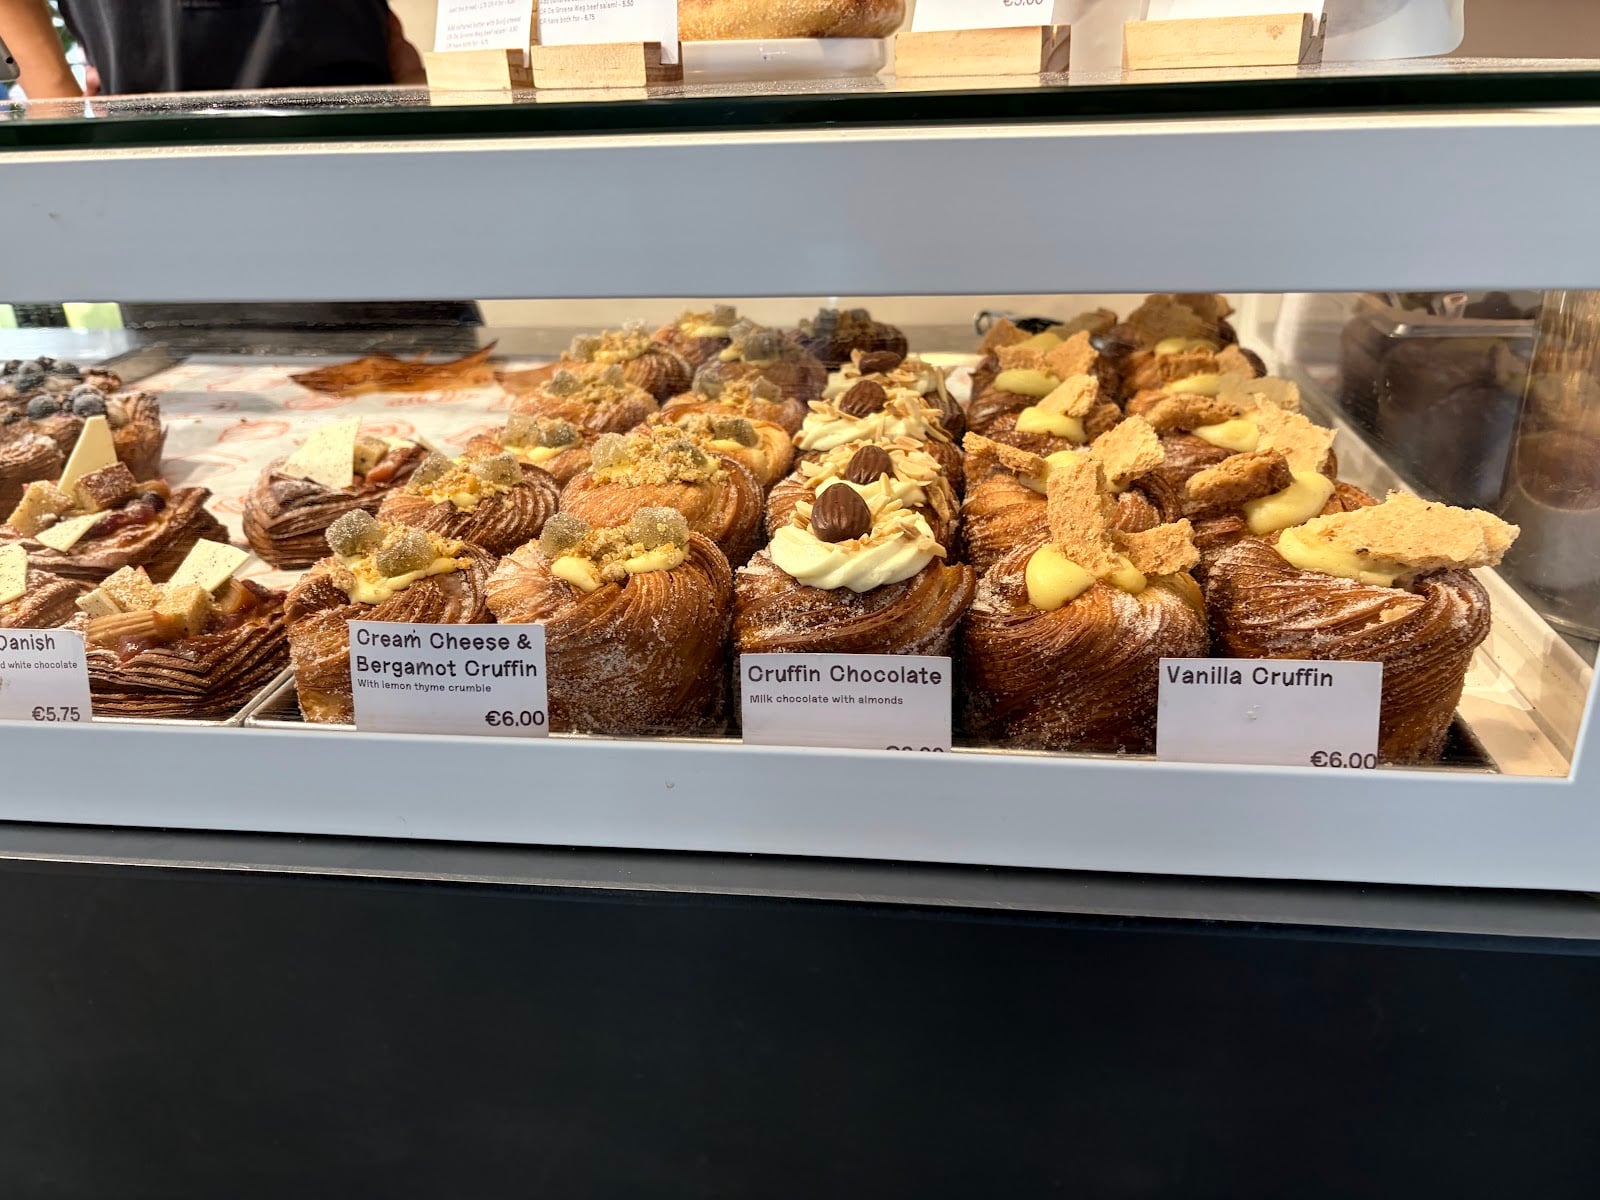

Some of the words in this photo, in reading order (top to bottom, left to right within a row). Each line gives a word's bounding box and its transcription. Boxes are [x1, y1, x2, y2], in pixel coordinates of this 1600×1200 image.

[357, 628, 421, 648] Cream
[430, 632, 510, 651] Cheese
[517, 633, 532, 650] &
[8, 661, 32, 669] white
[34, 660, 78, 669] chocolate
[357, 655, 457, 678] Bergamot
[465, 659, 537, 677] Cruffin
[748, 664, 820, 683] Cruffin
[830, 665, 942, 685] Chocolate
[1167, 666, 1242, 685] Vanilla
[1252, 667, 1333, 687] Cruffin
[357, 678, 380, 689] With
[382, 680, 411, 691] lemon
[414, 682, 445, 693] thyme
[448, 683, 492, 693] crumble
[749, 694, 773, 704] Milk
[776, 694, 829, 704] chocolate
[832, 694, 855, 704] with
[858, 695, 903, 705] almonds
[32, 706, 80, 722] €5.75
[485, 710, 545, 727] €6.00
[1310, 750, 1378, 769] €6.00
